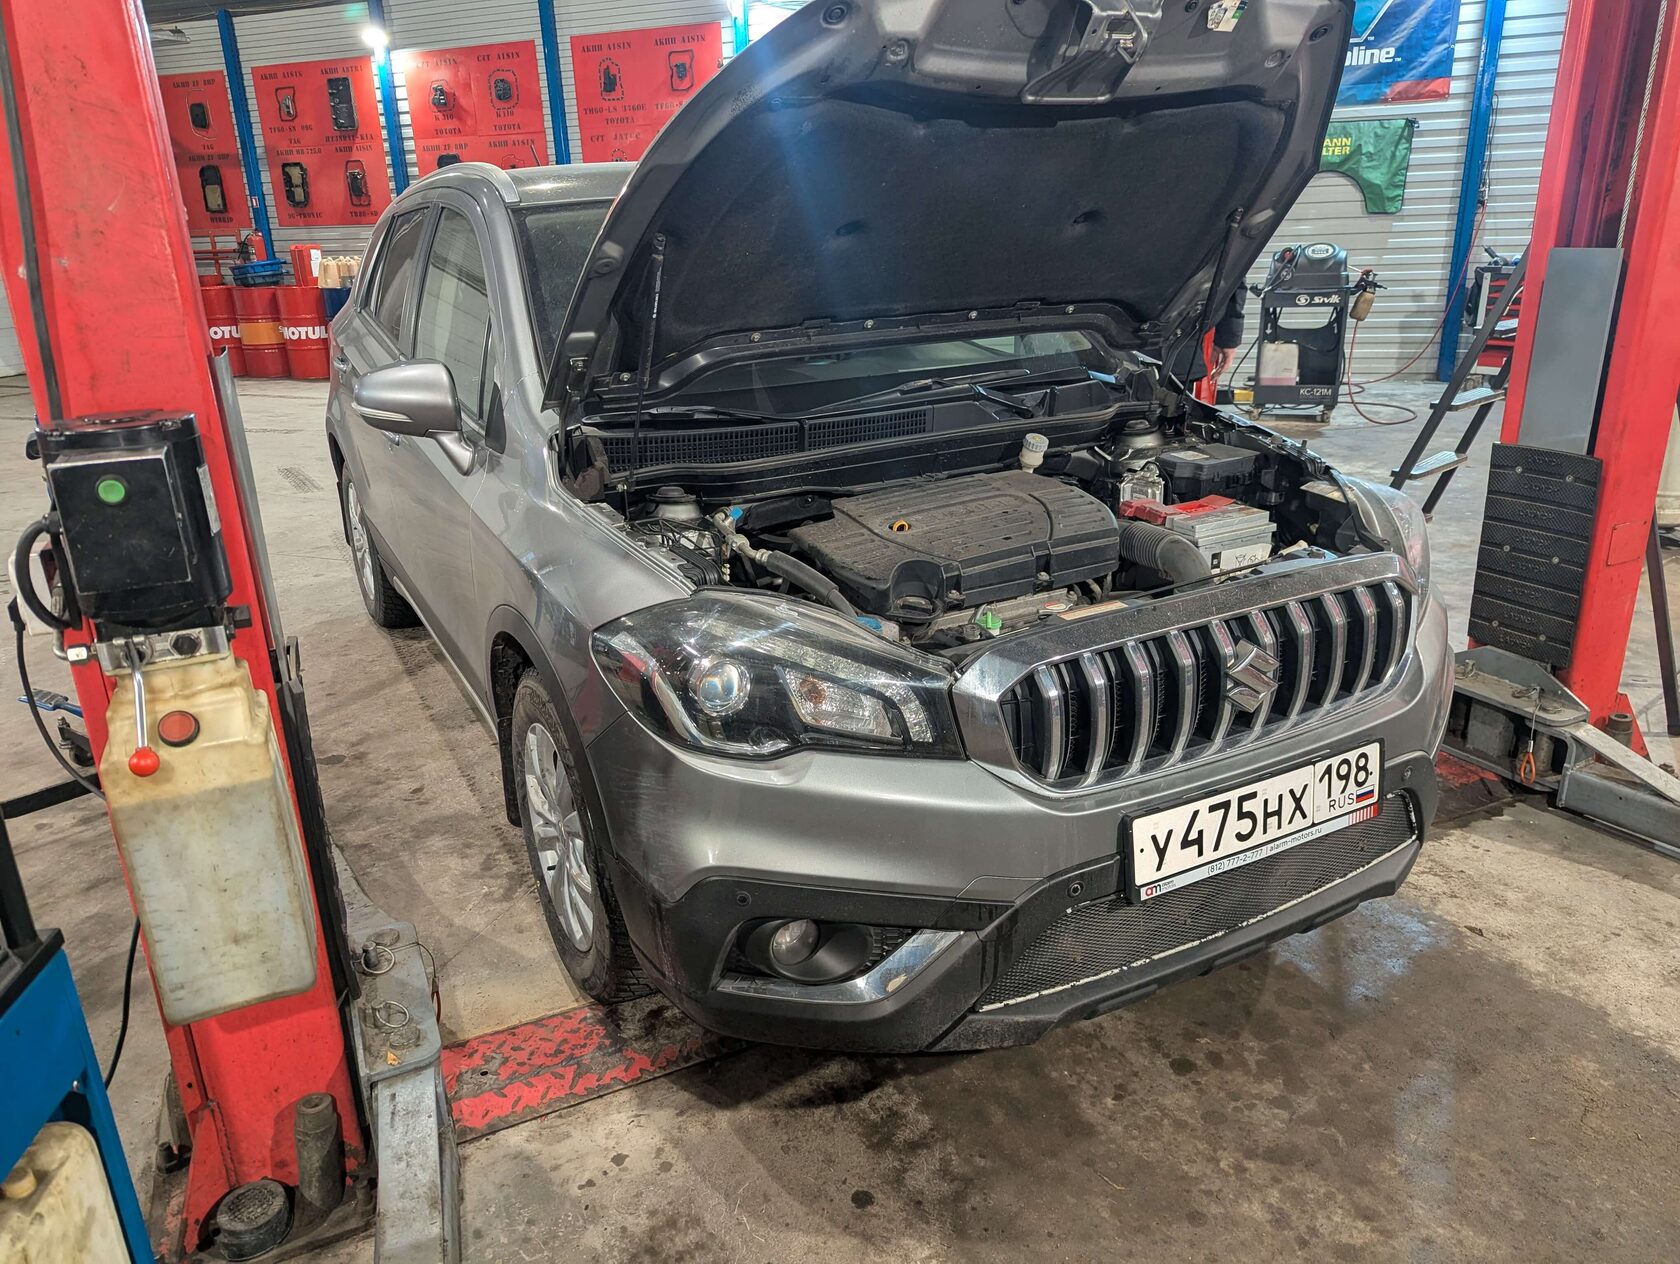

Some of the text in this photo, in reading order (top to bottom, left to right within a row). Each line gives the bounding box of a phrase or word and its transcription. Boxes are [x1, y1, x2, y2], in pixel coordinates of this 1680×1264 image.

[605, 117, 635, 125] TOYOTA
[435, 127, 462, 135] TOYOTA
[494, 123, 521, 131] TOYOTA
[1323, 137, 1352, 146] ANN
[1322, 146, 1350, 156] LTER
[209, 325, 241, 340] OTU
[1318, 751, 1370, 799] 198
[1328, 792, 1355, 813] RUS
[1207, 827, 1322, 876] (812) 777-2-777 alarm-motors.ru
